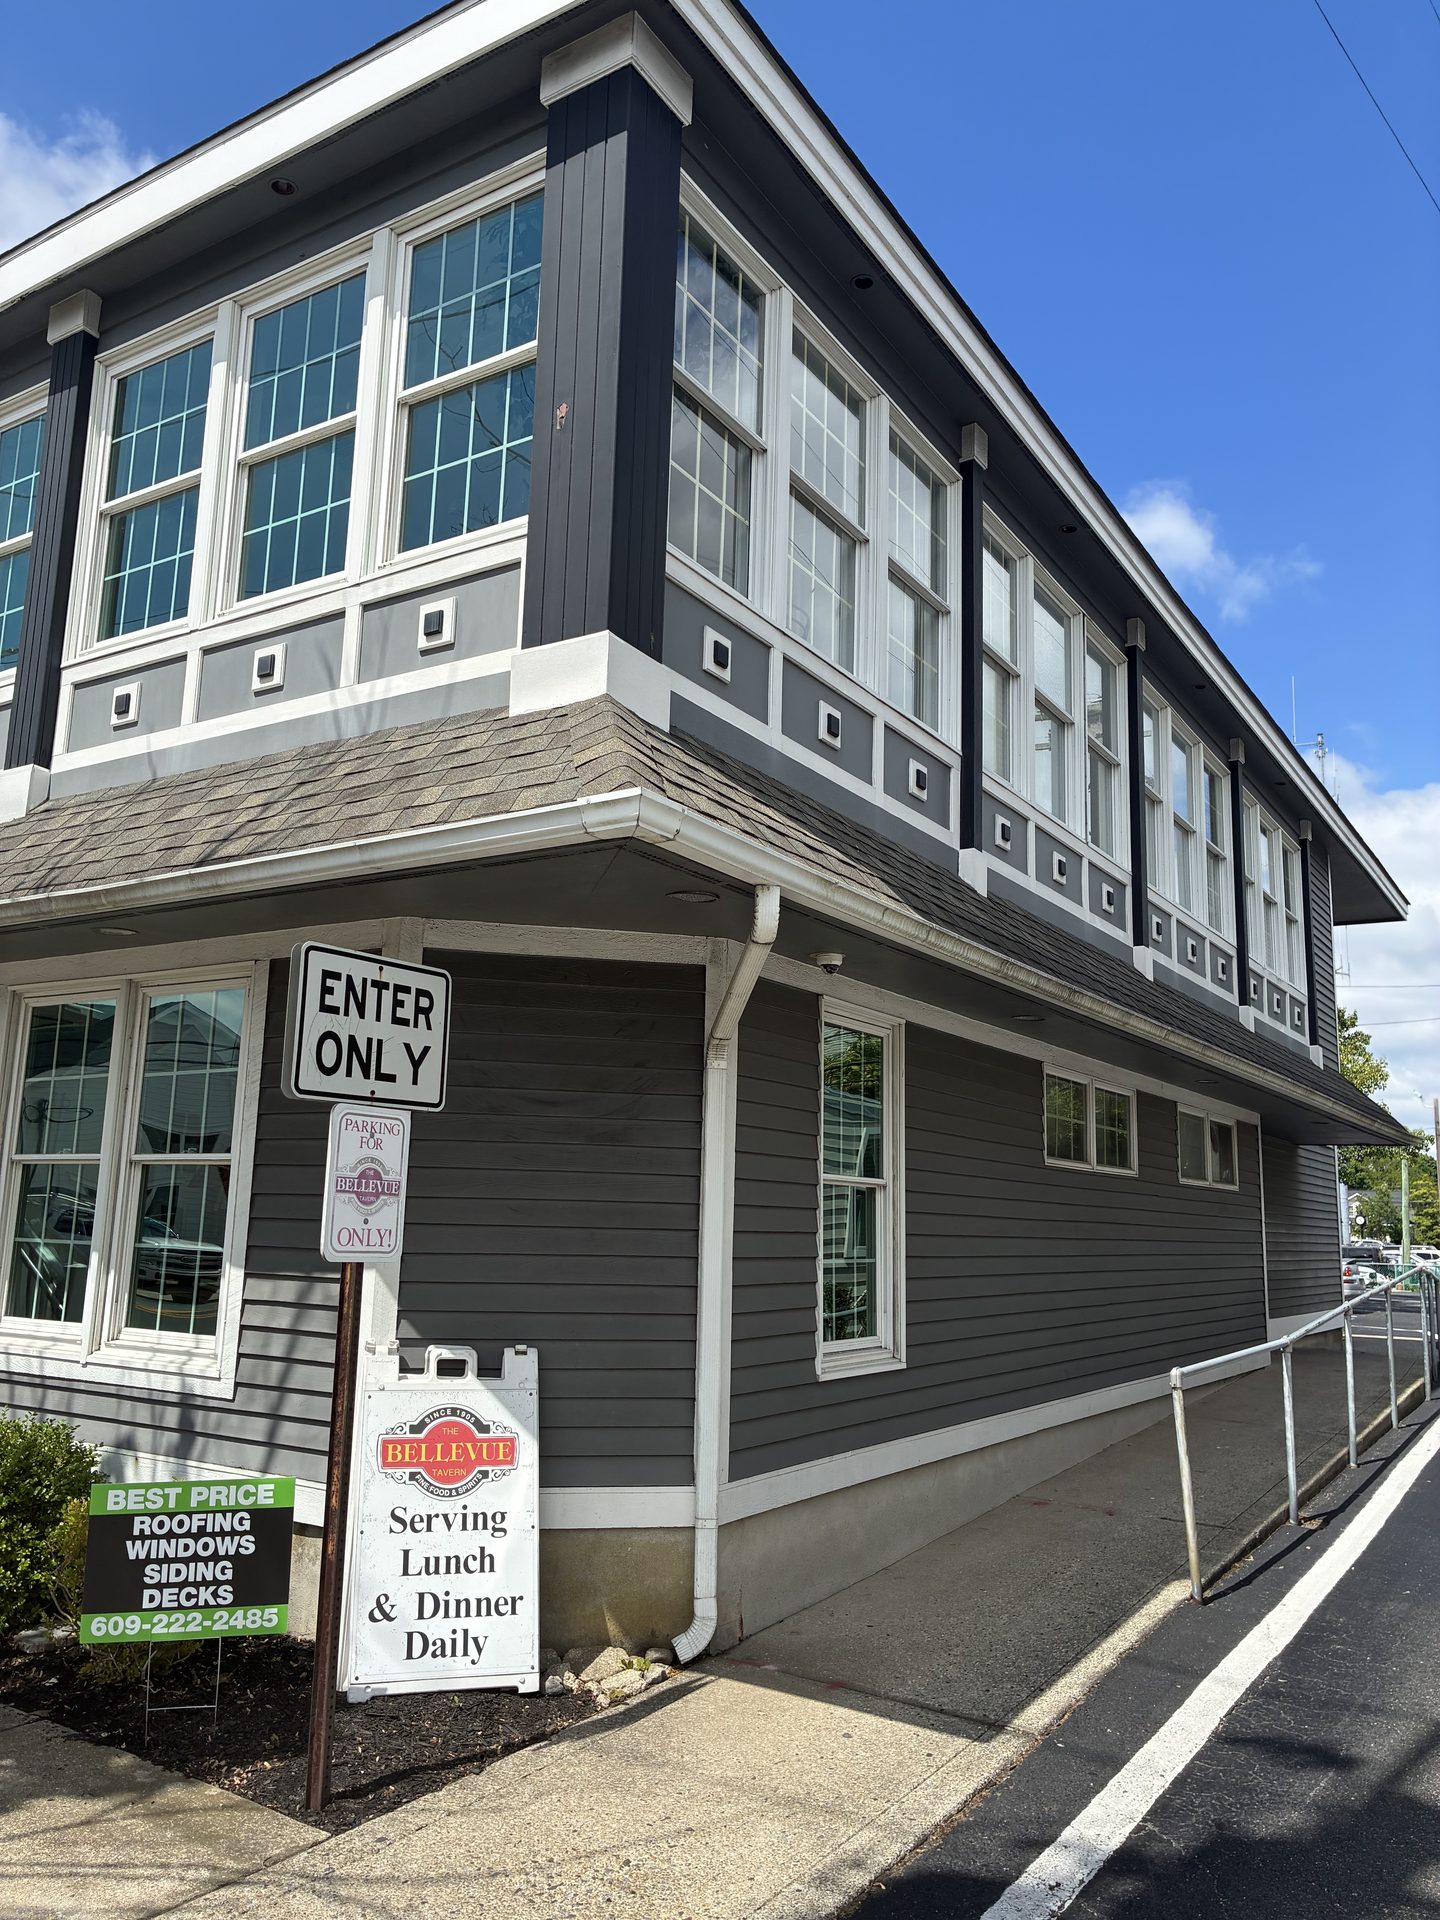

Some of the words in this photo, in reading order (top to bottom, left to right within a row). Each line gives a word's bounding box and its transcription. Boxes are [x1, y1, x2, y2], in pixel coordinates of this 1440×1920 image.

[319, 968, 434, 1031] ENTER
[315, 1030, 431, 1086] ONLY
[344, 1118, 400, 1137] PARKING
[359, 1136, 383, 1150] FOR
[337, 1177, 400, 1194] BELLEVUE
[337, 1227, 392, 1248] ONLY!
[424, 1408, 452, 1424] SINCE
[456, 1409, 476, 1423] 1905
[442, 1427, 459, 1435] THE
[385, 1442, 512, 1463] BELLEVUE
[415, 1474, 430, 1489] FINE
[429, 1486, 450, 1496] FOOD
[458, 1473, 483, 1494] SPIRITS
[432, 1468, 467, 1477] TAVERN
[106, 1487, 182, 1511] BEST
[190, 1483, 275, 1508] PRICE
[132, 1512, 251, 1536] ROOFING
[388, 1504, 508, 1538] Serving
[125, 1535, 256, 1560] WINDOWS
[143, 1561, 234, 1585] SIDING
[400, 1546, 496, 1577] Lunch
[142, 1585, 234, 1609] DECKS
[368, 1593, 398, 1623] &
[414, 1590, 524, 1621] Dinner
[90, 1608, 279, 1637] 609-222-2485
[402, 1628, 489, 1666] Daily
